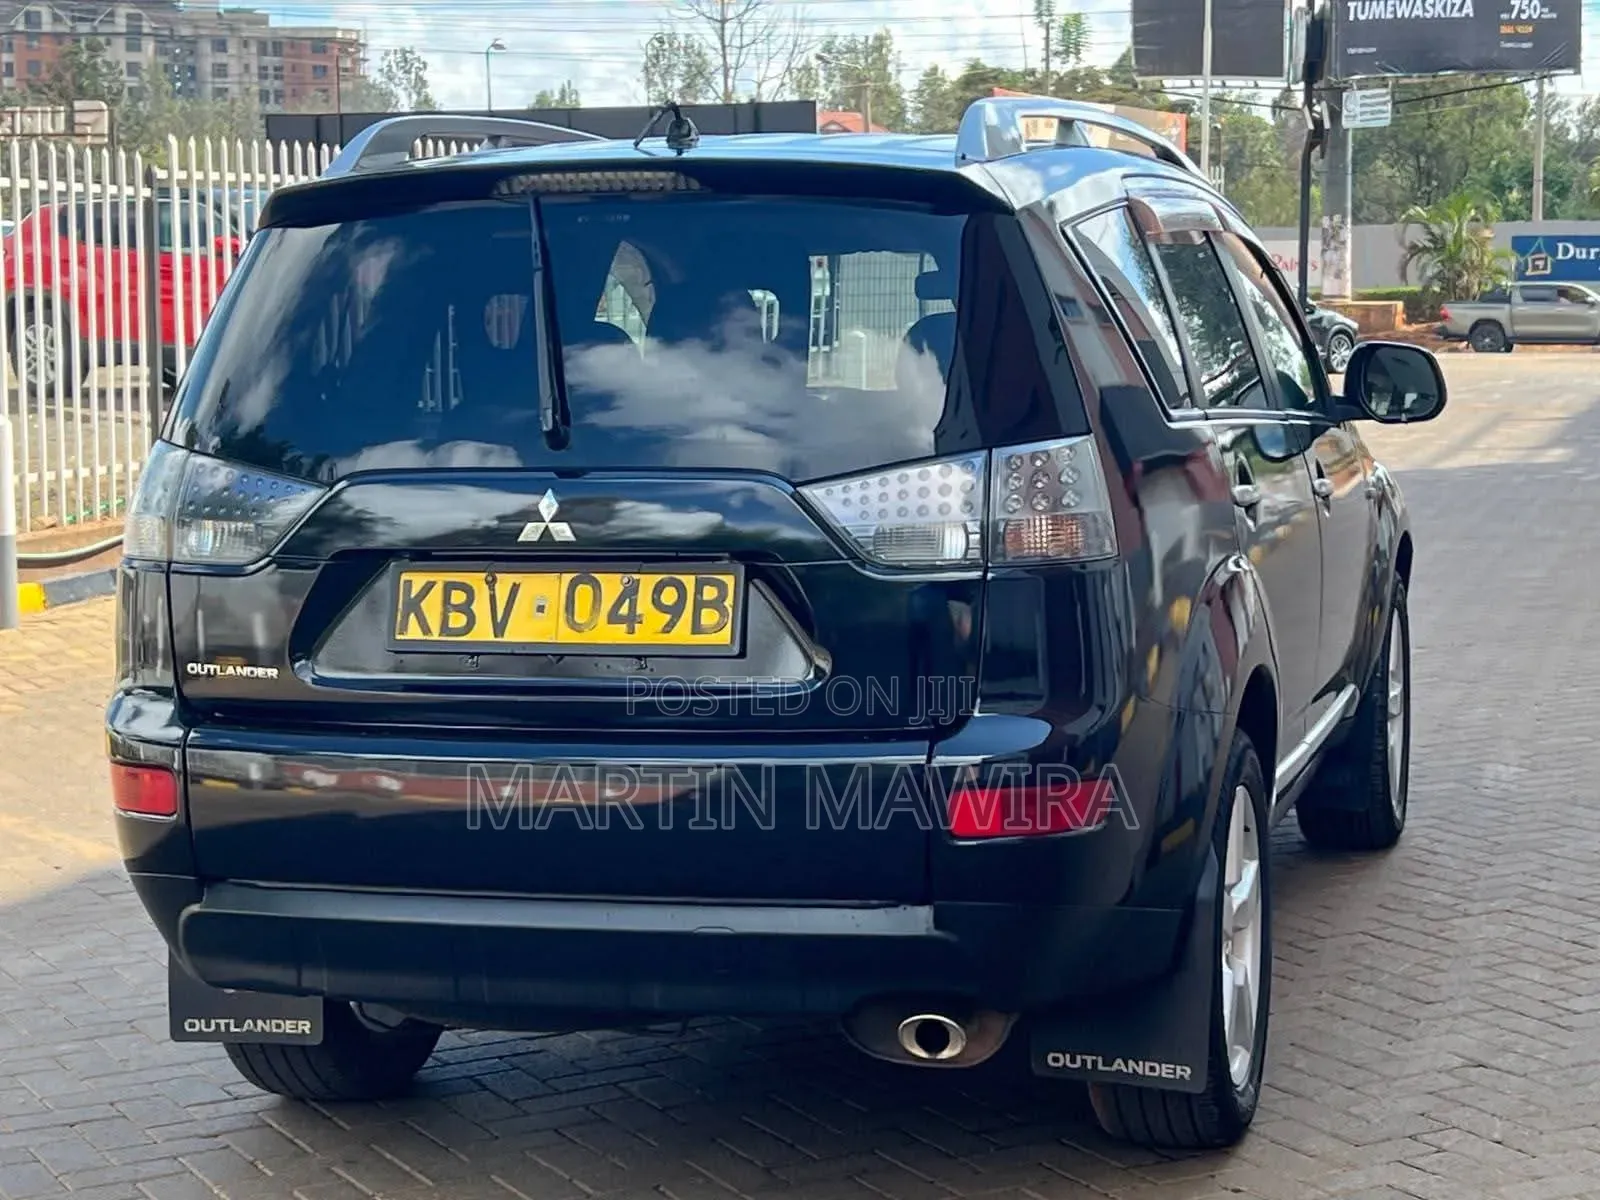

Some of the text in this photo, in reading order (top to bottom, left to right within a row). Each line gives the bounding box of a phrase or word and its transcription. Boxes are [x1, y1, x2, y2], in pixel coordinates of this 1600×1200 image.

[1347, 0, 1474, 21] TUMEWASKIZA
[1509, 0, 1541, 19] 750
[397, 573, 730, 638] KBV 049B
[187, 663, 278, 678] OUTLANDER
[184, 1018, 311, 1034] OUTLANDER
[1047, 1052, 1192, 1080] OUTLANDER
